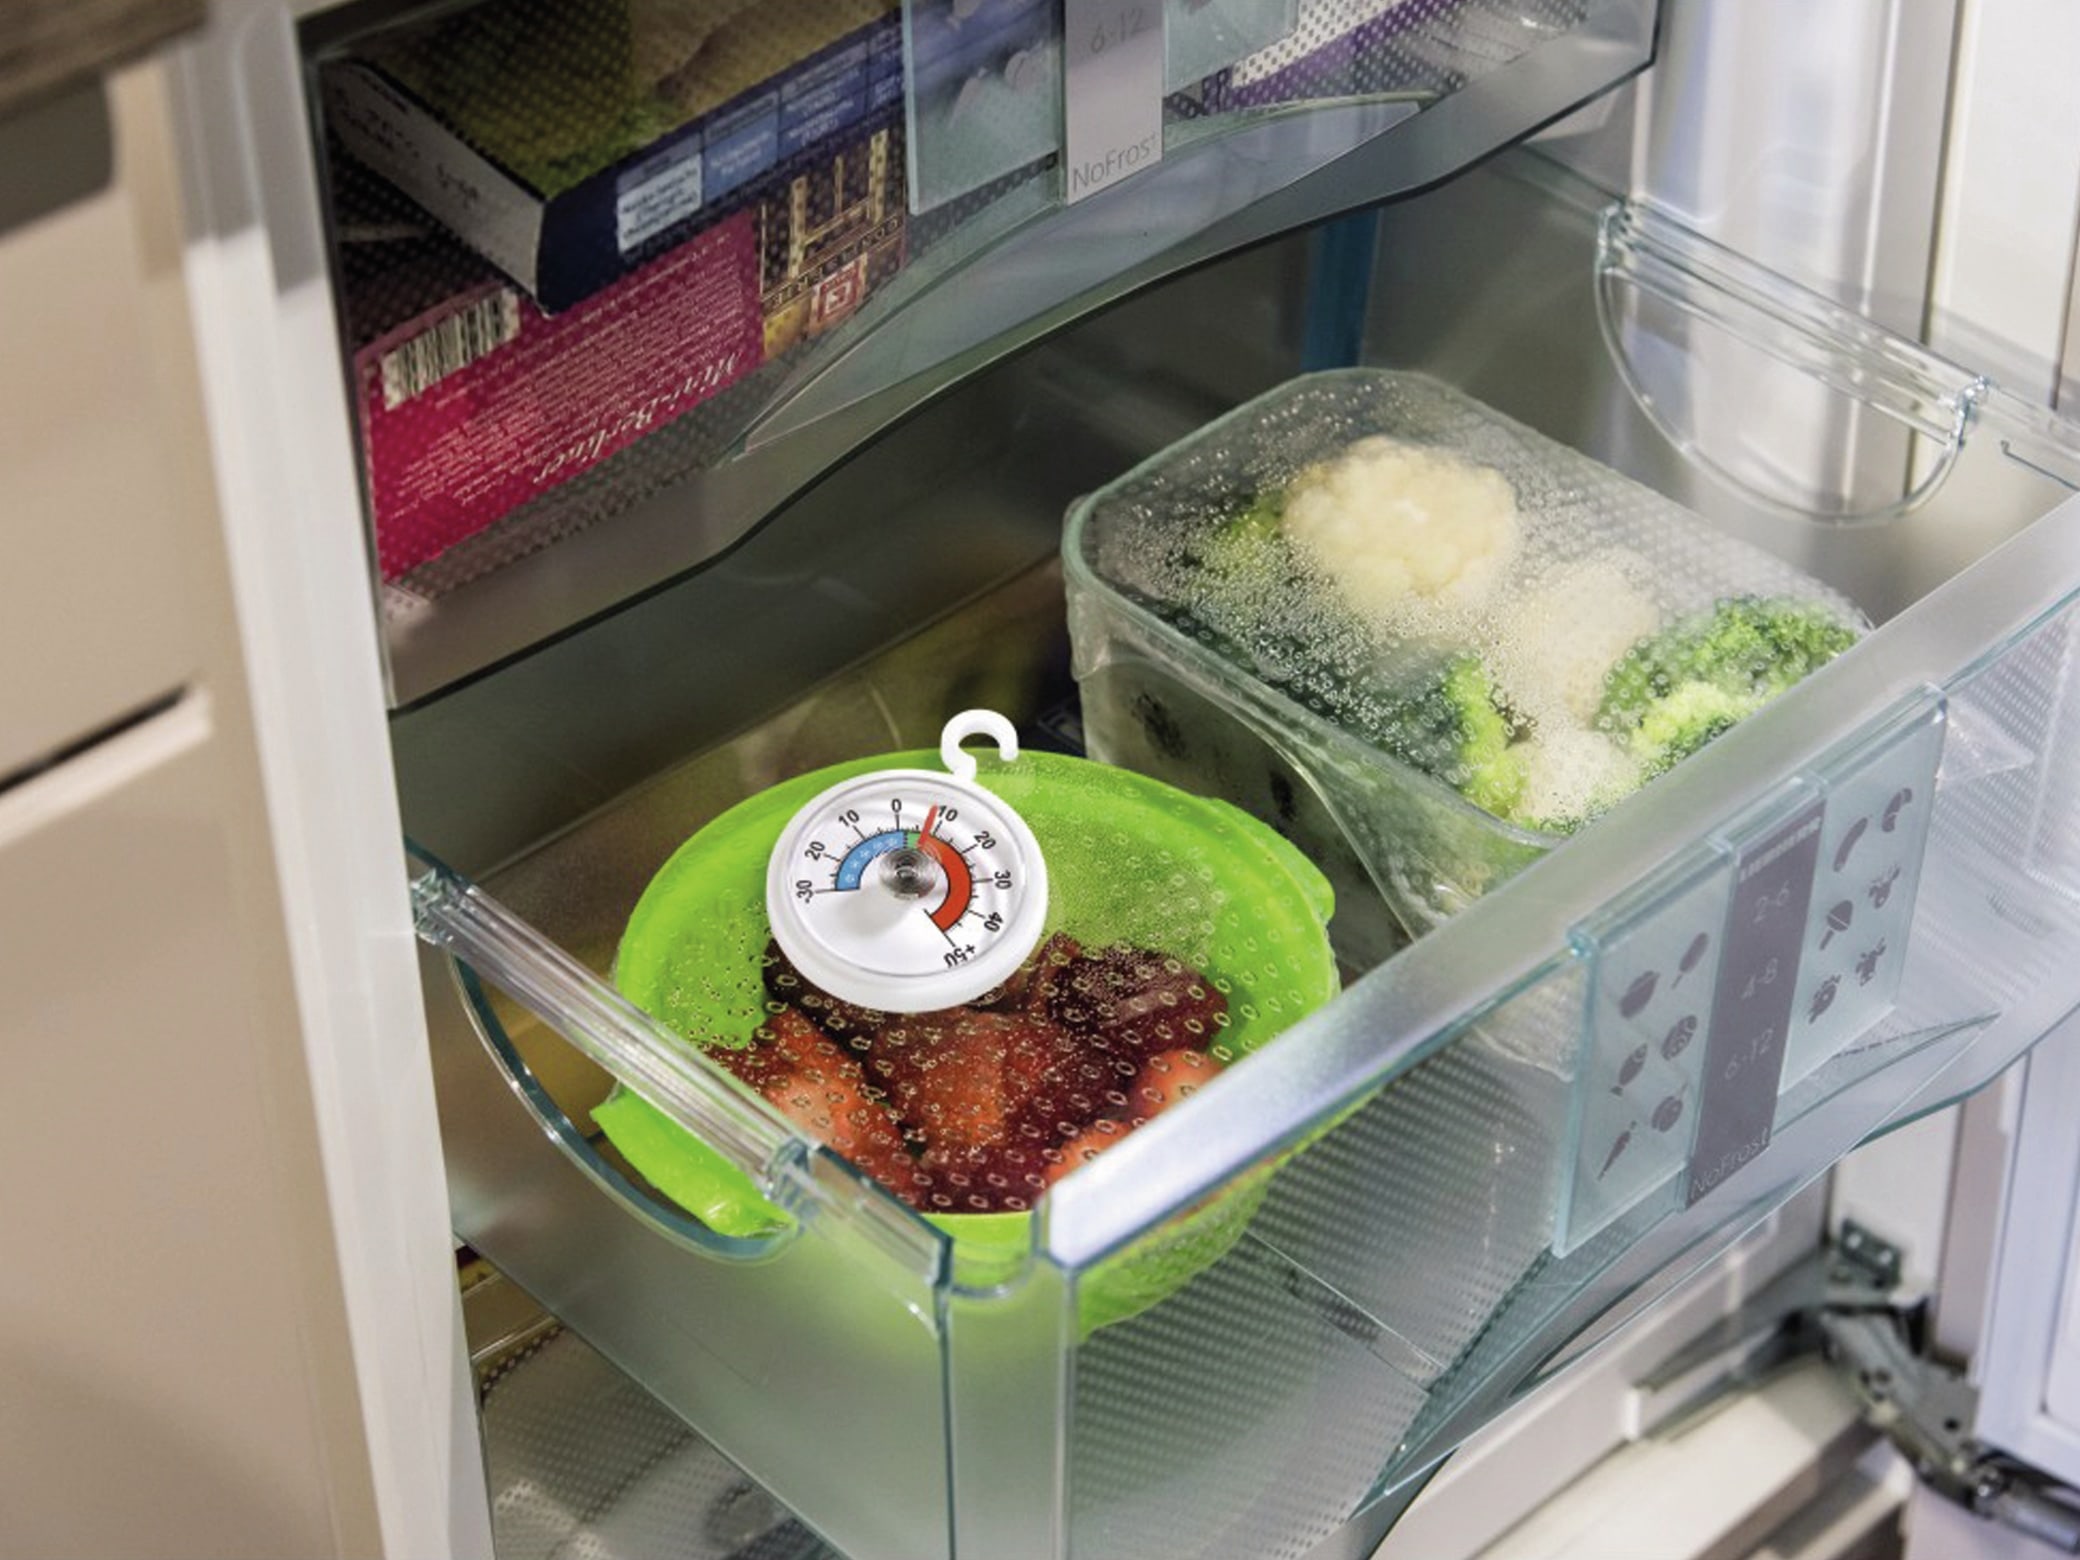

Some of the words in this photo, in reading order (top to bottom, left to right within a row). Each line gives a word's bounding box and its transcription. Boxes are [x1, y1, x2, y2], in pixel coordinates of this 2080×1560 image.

[532, 350, 742, 484] Mini-Berliner
[890, 798, 902, 813] 0
[937, 804, 958, 822] 10
[838, 809, 860, 828] 10
[804, 840, 826, 861] 20
[973, 830, 997, 851] 20
[993, 870, 1012, 890] 30
[983, 911, 1004, 933] 40
[943, 943, 977, 968] +50
[1690, 1125, 1771, 1202] NoFrost
